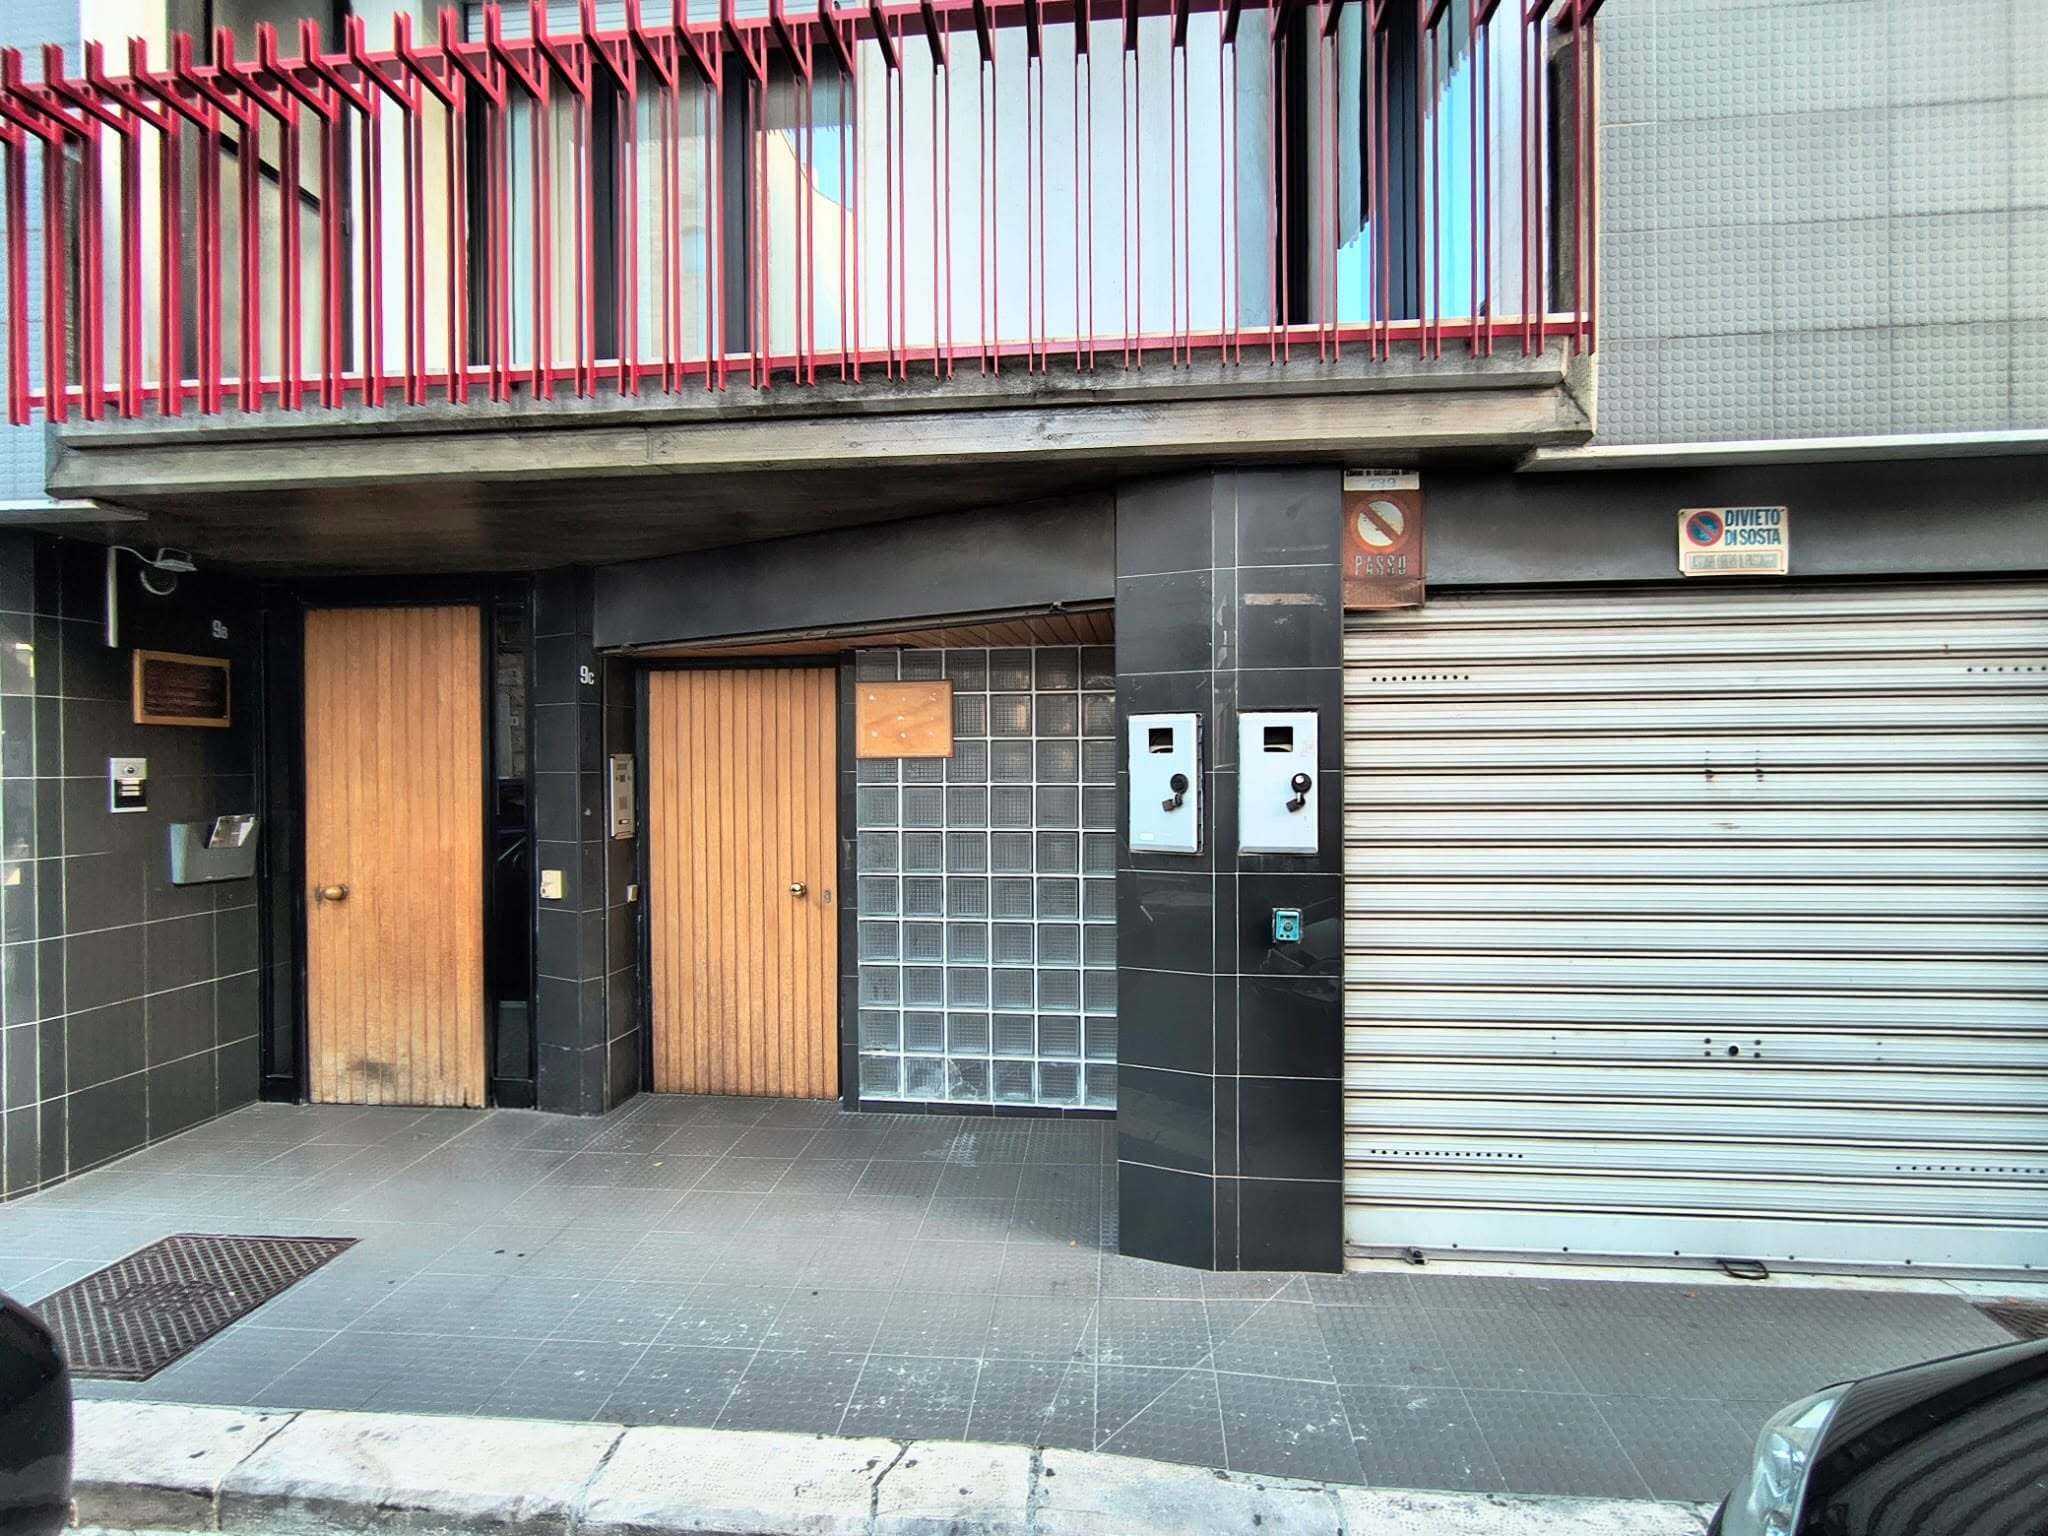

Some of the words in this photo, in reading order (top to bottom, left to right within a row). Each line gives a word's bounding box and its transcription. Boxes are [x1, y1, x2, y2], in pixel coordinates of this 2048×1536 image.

[1725, 509, 1781, 526] DIVIETO
[1725, 529, 1737, 545] DI
[1739, 528, 1781, 545] SOSTA
